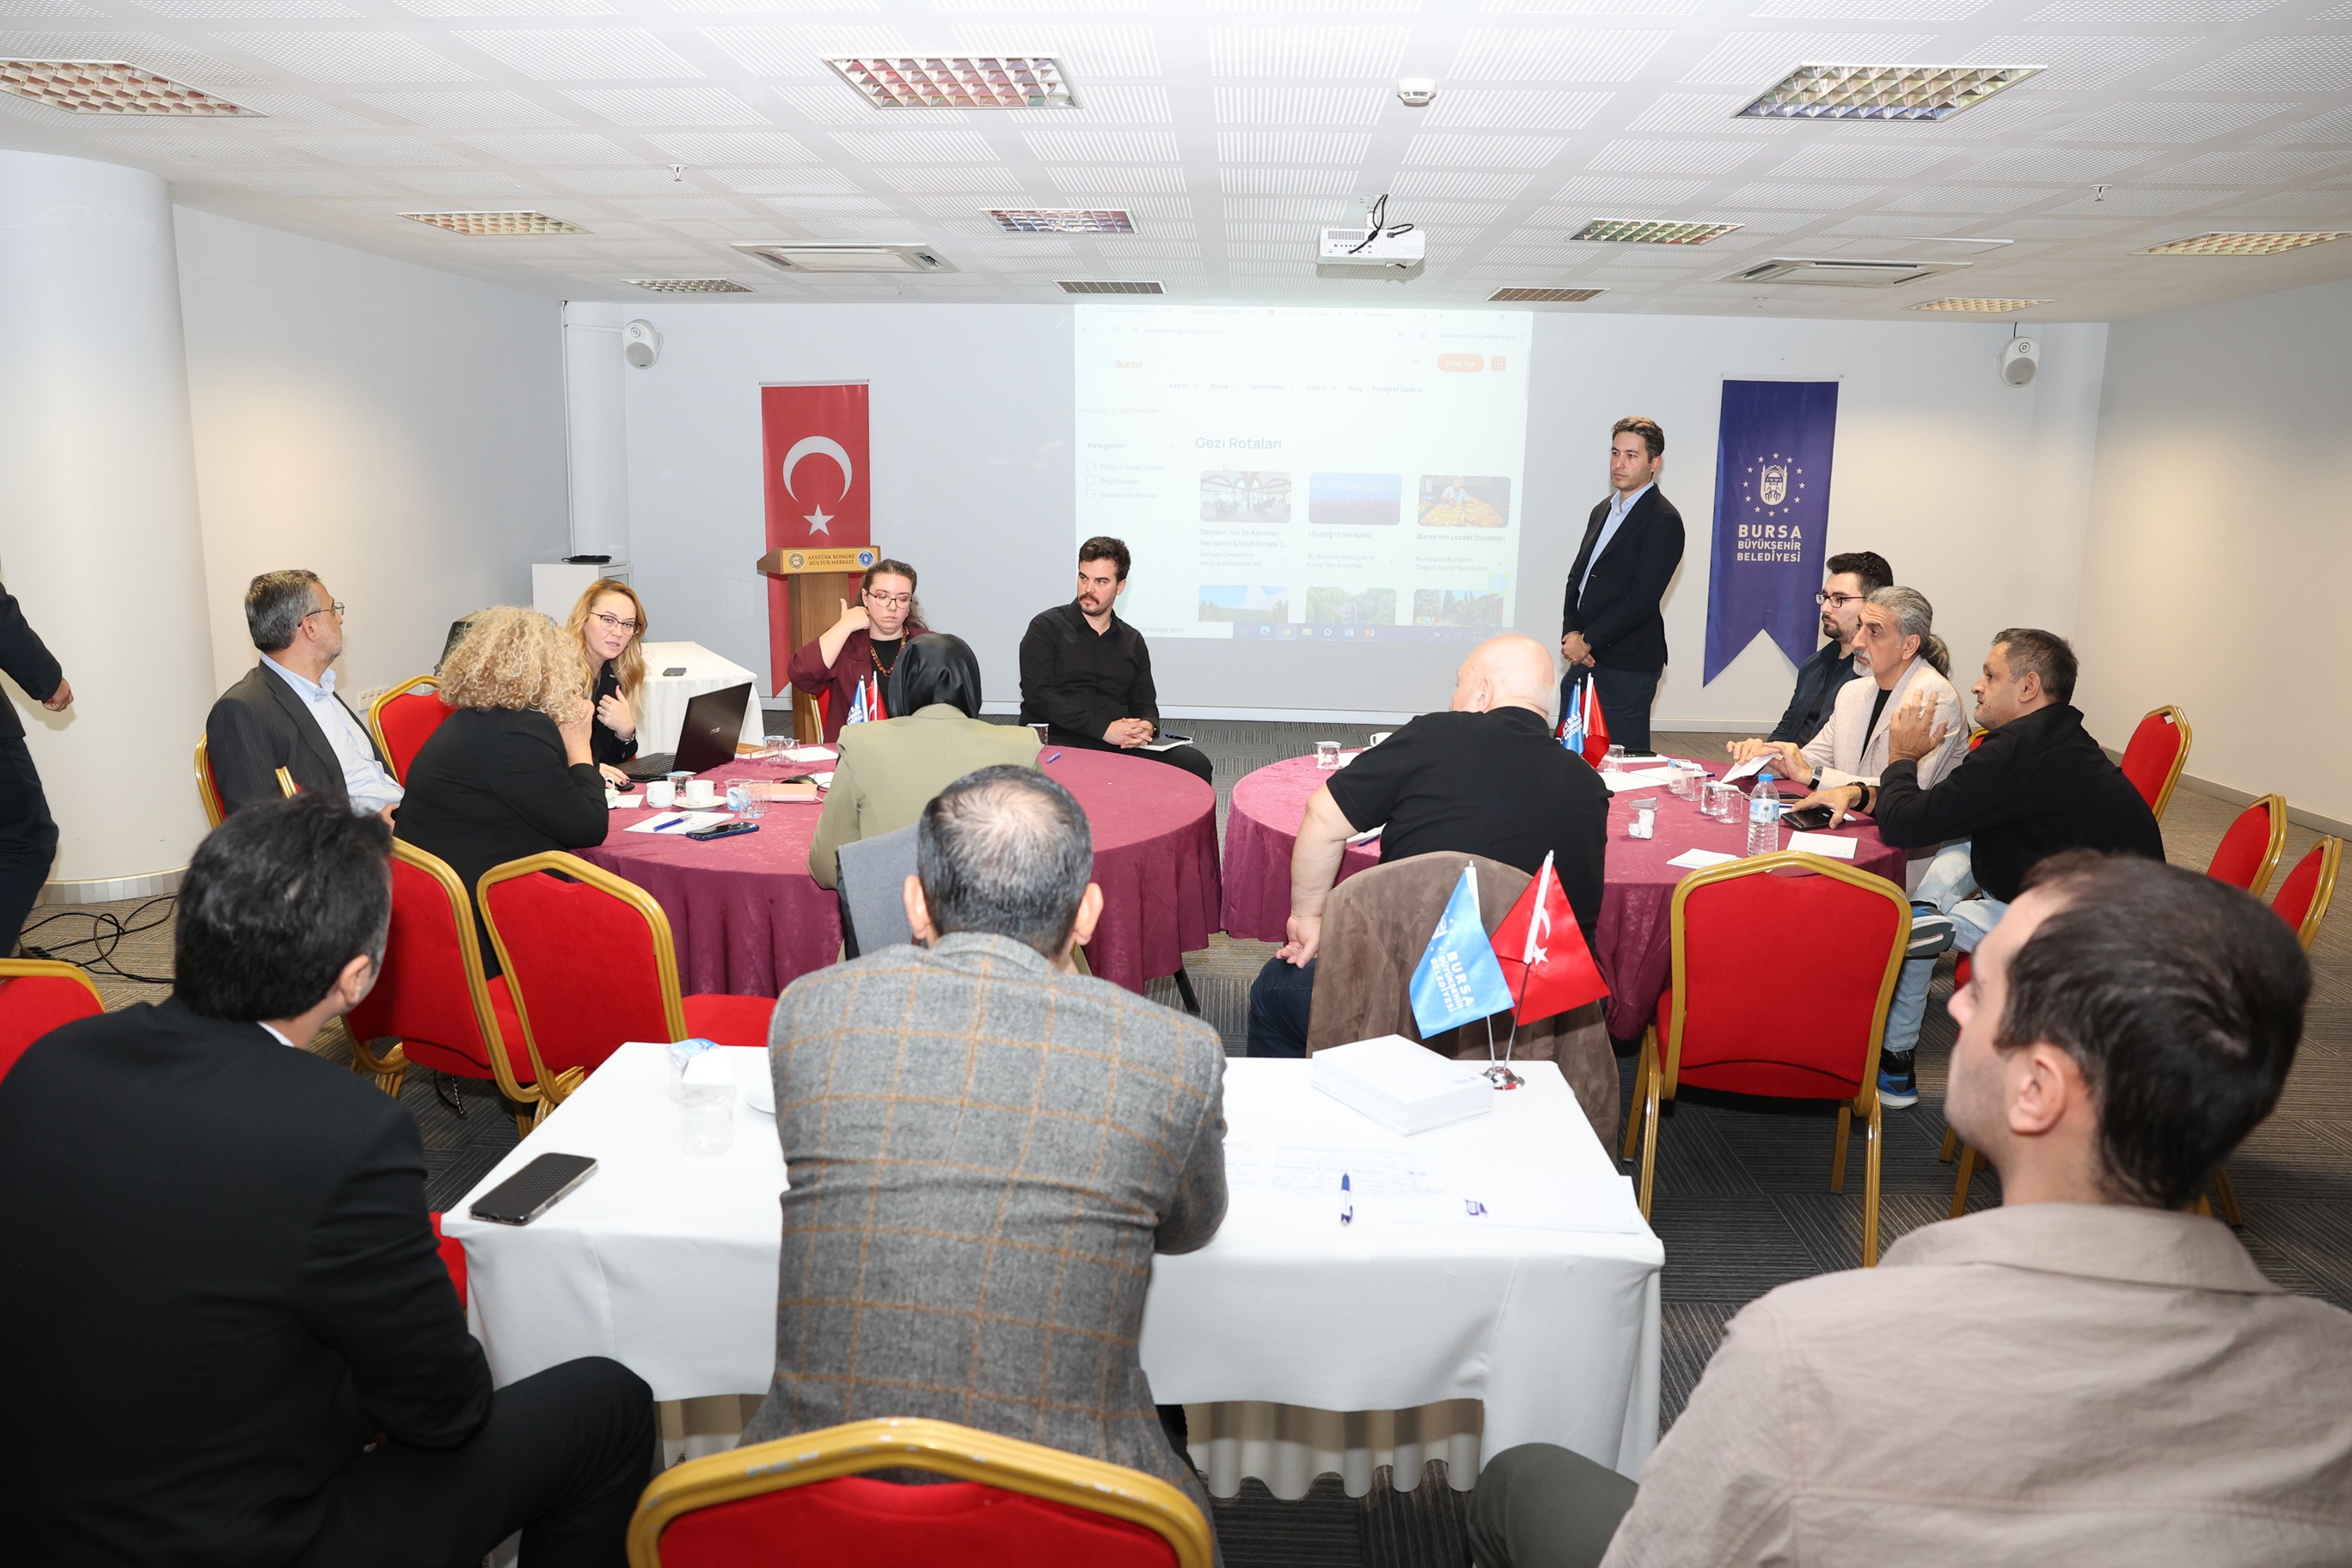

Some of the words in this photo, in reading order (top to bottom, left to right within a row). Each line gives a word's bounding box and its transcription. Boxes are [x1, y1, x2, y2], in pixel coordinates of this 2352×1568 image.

[1463, 359, 1476, 368] Yap
[1196, 437, 1226, 449] Gezi
[1229, 438, 1282, 450] Rotaları
[1738, 524, 1802, 538] BURSA
[1737, 538, 1801, 551] BÜYÜKŞEHİR
[1736, 551, 1801, 562] BELEDİYESİ
[1438, 954, 1464, 1009] BÜYÜKŞEHİR
[1447, 951, 1475, 1007] BURSA
[1430, 959, 1457, 1013] BELEDİYESİ
